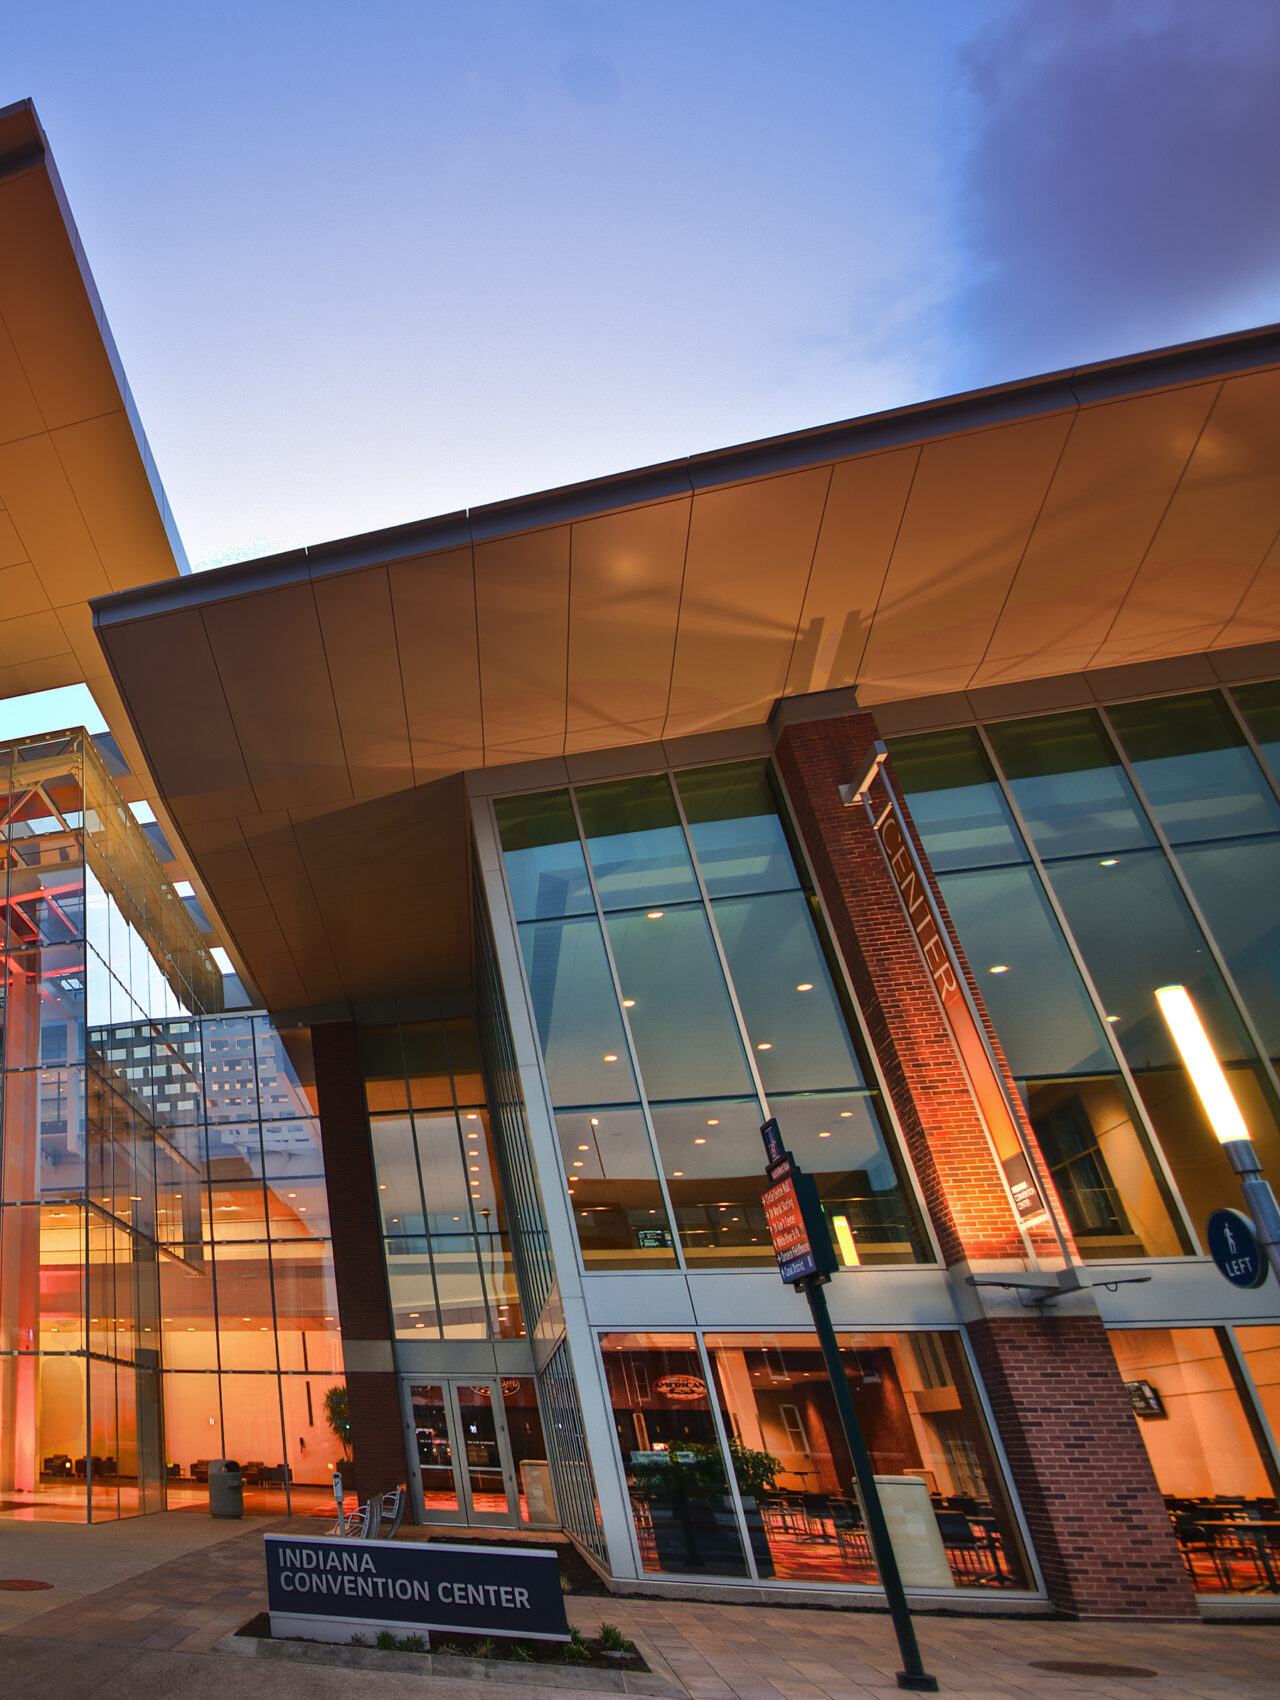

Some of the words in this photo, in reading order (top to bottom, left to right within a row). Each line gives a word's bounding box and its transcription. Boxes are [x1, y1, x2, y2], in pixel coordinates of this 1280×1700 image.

[882, 818, 957, 1001] CENTER
[1225, 1257, 1252, 1277] LEFT
[278, 1547, 376, 1573] INDIANA
[280, 1571, 430, 1601] CONVENTION
[437, 1581, 531, 1609] CENTER
